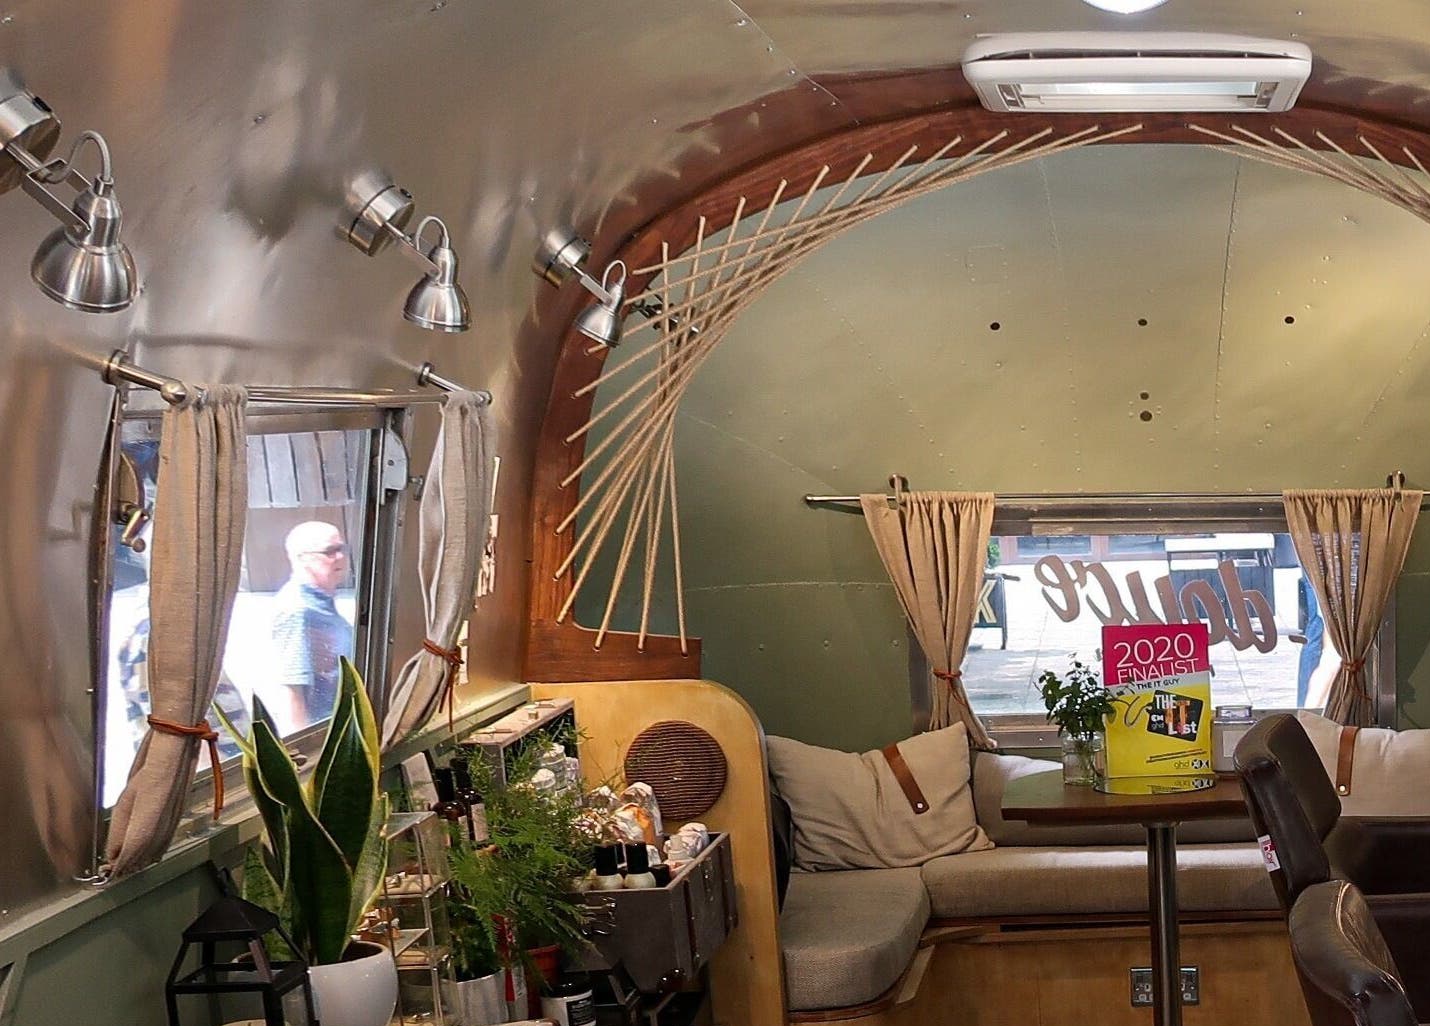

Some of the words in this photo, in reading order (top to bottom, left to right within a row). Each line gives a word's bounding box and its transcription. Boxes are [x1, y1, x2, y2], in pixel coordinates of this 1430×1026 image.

[1113, 633, 1195, 668] 2020
[1117, 658, 1199, 684] FINALIST
[1136, 681, 1152, 690] THE
[1154, 680, 1162, 688] IT
[1163, 678, 1180, 686] GUY
[1155, 694, 1176, 709] THE
[1174, 760, 1190, 770] ghd
